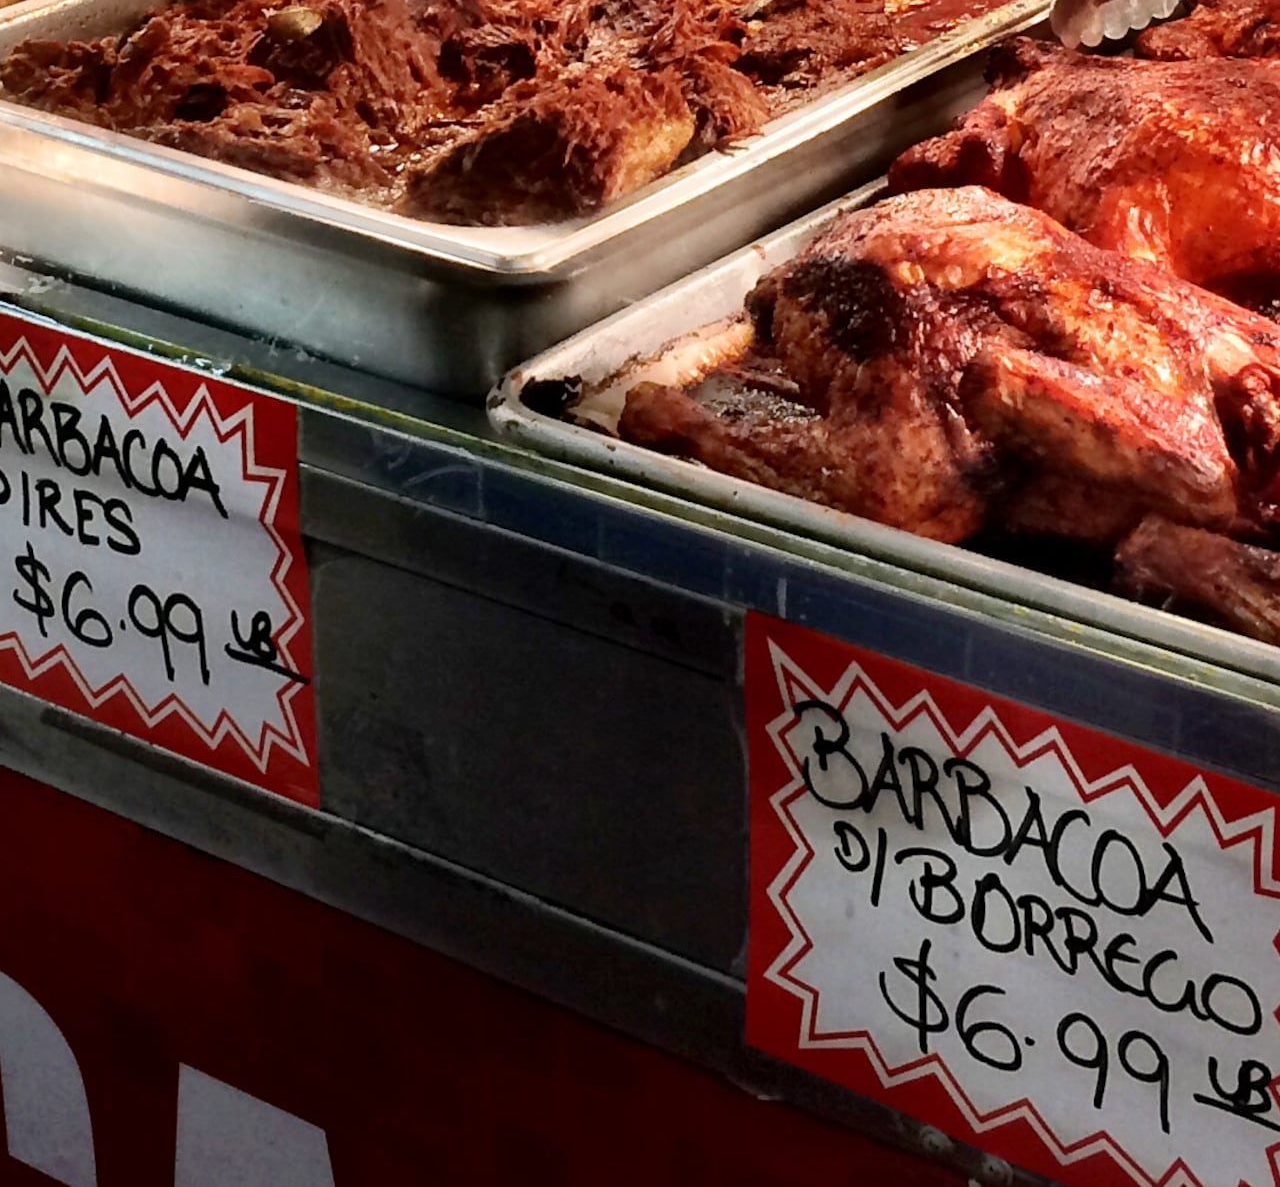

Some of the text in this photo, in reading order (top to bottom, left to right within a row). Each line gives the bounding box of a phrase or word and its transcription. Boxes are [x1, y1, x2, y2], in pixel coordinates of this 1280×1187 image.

[13, 541, 286, 686] $6.99 LB
[793, 700, 1214, 944] BARBACOA
[879, 939, 1171, 1134] $6.99
